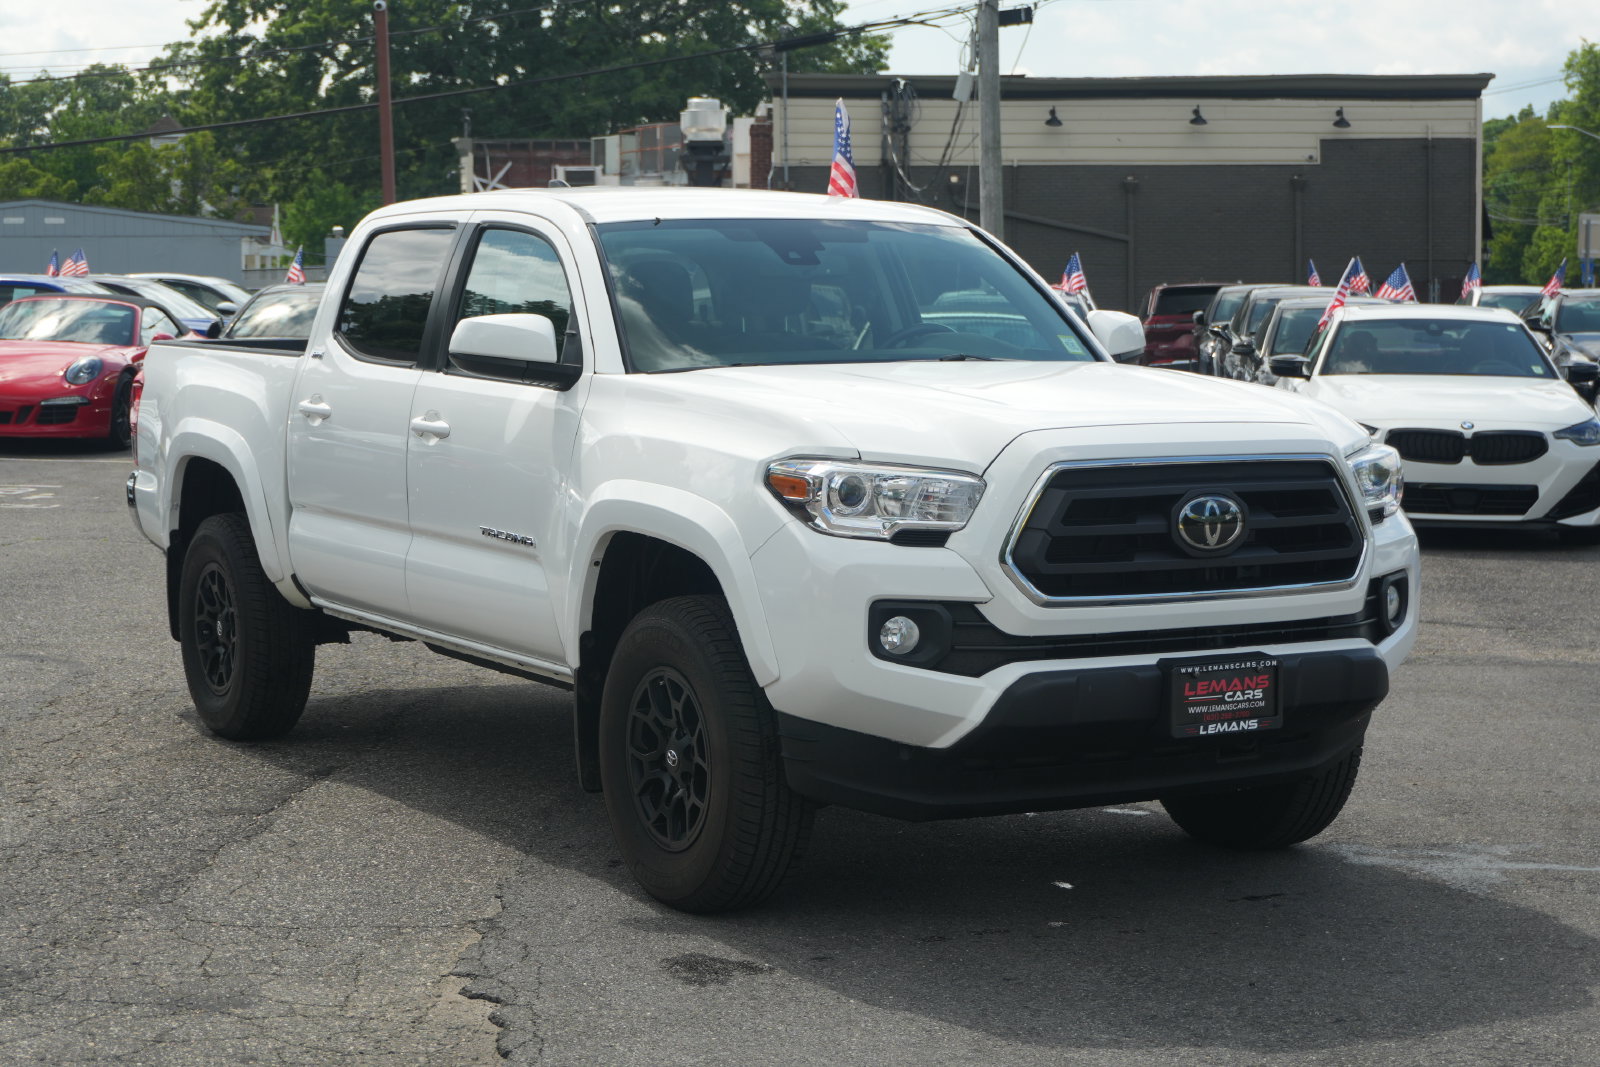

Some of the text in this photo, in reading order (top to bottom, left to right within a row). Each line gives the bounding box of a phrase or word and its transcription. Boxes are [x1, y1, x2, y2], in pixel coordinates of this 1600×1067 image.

[480, 526, 534, 546] TACOMA
[1180, 660, 1277, 673] WWW.LEMANSCARS.COM
[1184, 675, 1270, 696] LEMANS
[1224, 689, 1263, 702] CARS
[1188, 701, 1265, 714] WWW.LEMANSCARS.COM
[1199, 719, 1258, 735] LEMANS
